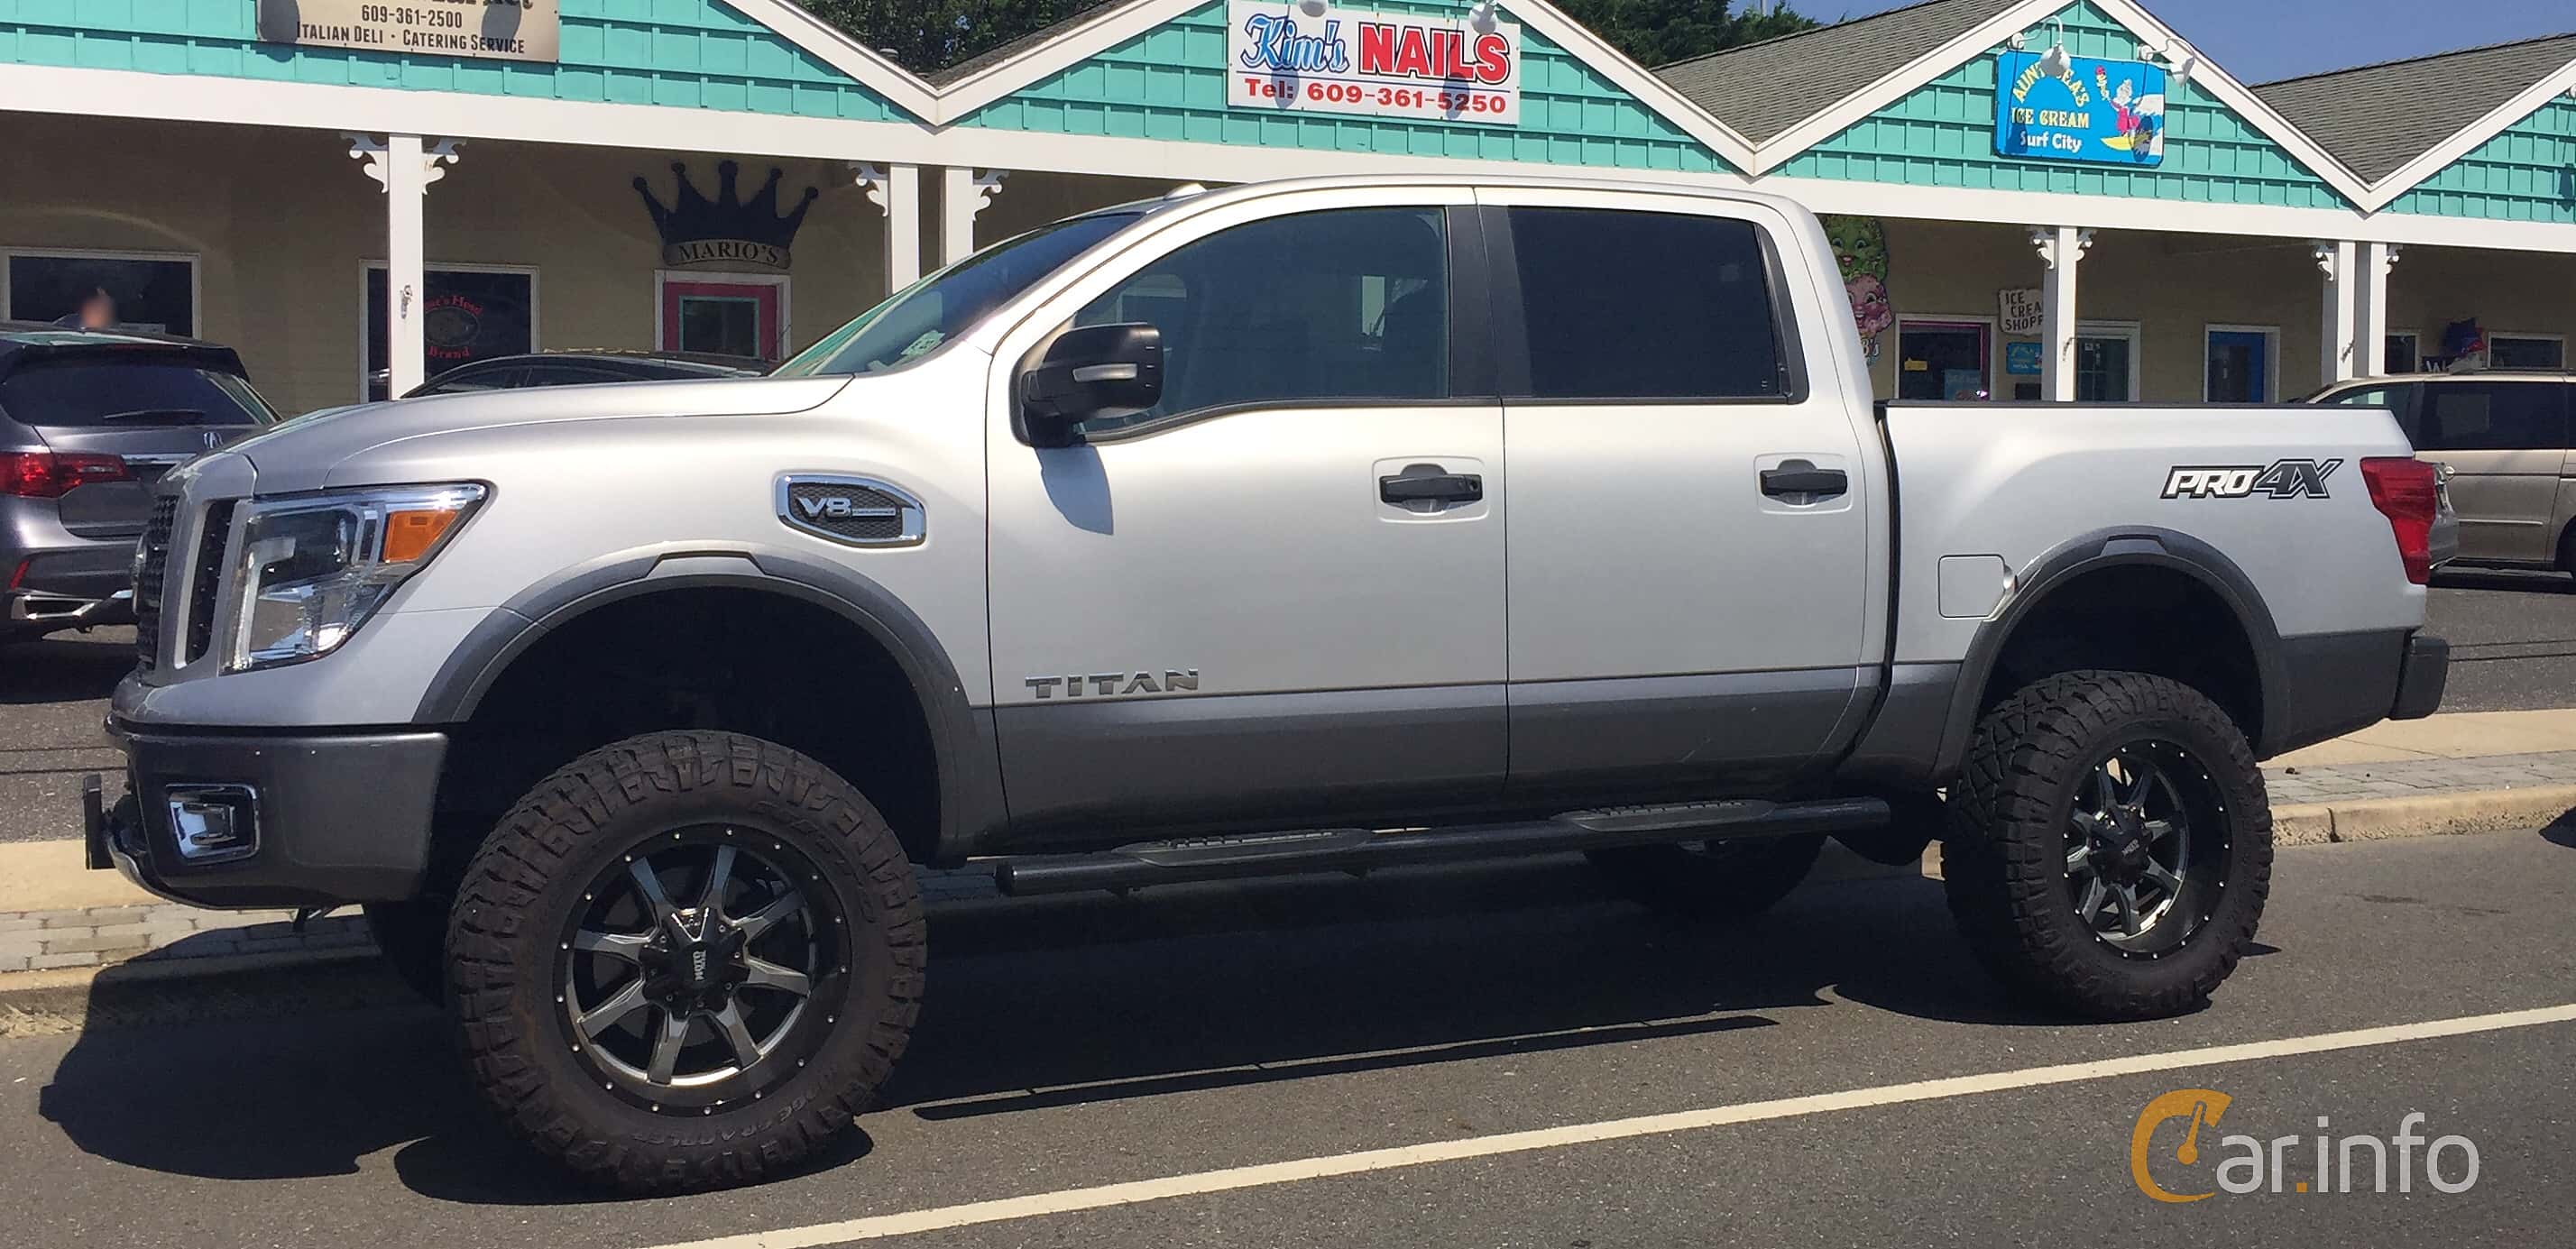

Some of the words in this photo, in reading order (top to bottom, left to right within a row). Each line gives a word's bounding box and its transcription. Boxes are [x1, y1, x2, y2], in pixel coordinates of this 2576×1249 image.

[361, 5, 463, 28] 609-361-2500
[297, 22, 350, 41] ITALIAN
[354, 25, 383, 44] DELI
[402, 29, 467, 51] CATERING
[471, 34, 525, 54] SERVICE
[1240, 13, 1350, 73] Kim's
[1357, 22, 1512, 85] NAILS
[1245, 78, 1293, 99] Tel:
[1307, 81, 1506, 114] 609-361-5250
[2011, 107, 2034, 124] ICE
[2039, 110, 2090, 128] CREAM
[2020, 131, 2049, 148] Surf
[2052, 132, 2083, 153] City
[678, 242, 779, 264] MARIO'S
[2005, 290, 2025, 305] ICE
[2010, 301, 2043, 318] CREA
[2005, 315, 2044, 331] SHOPP
[797, 497, 852, 518] V8
[1025, 668, 1199, 699] TITAN
